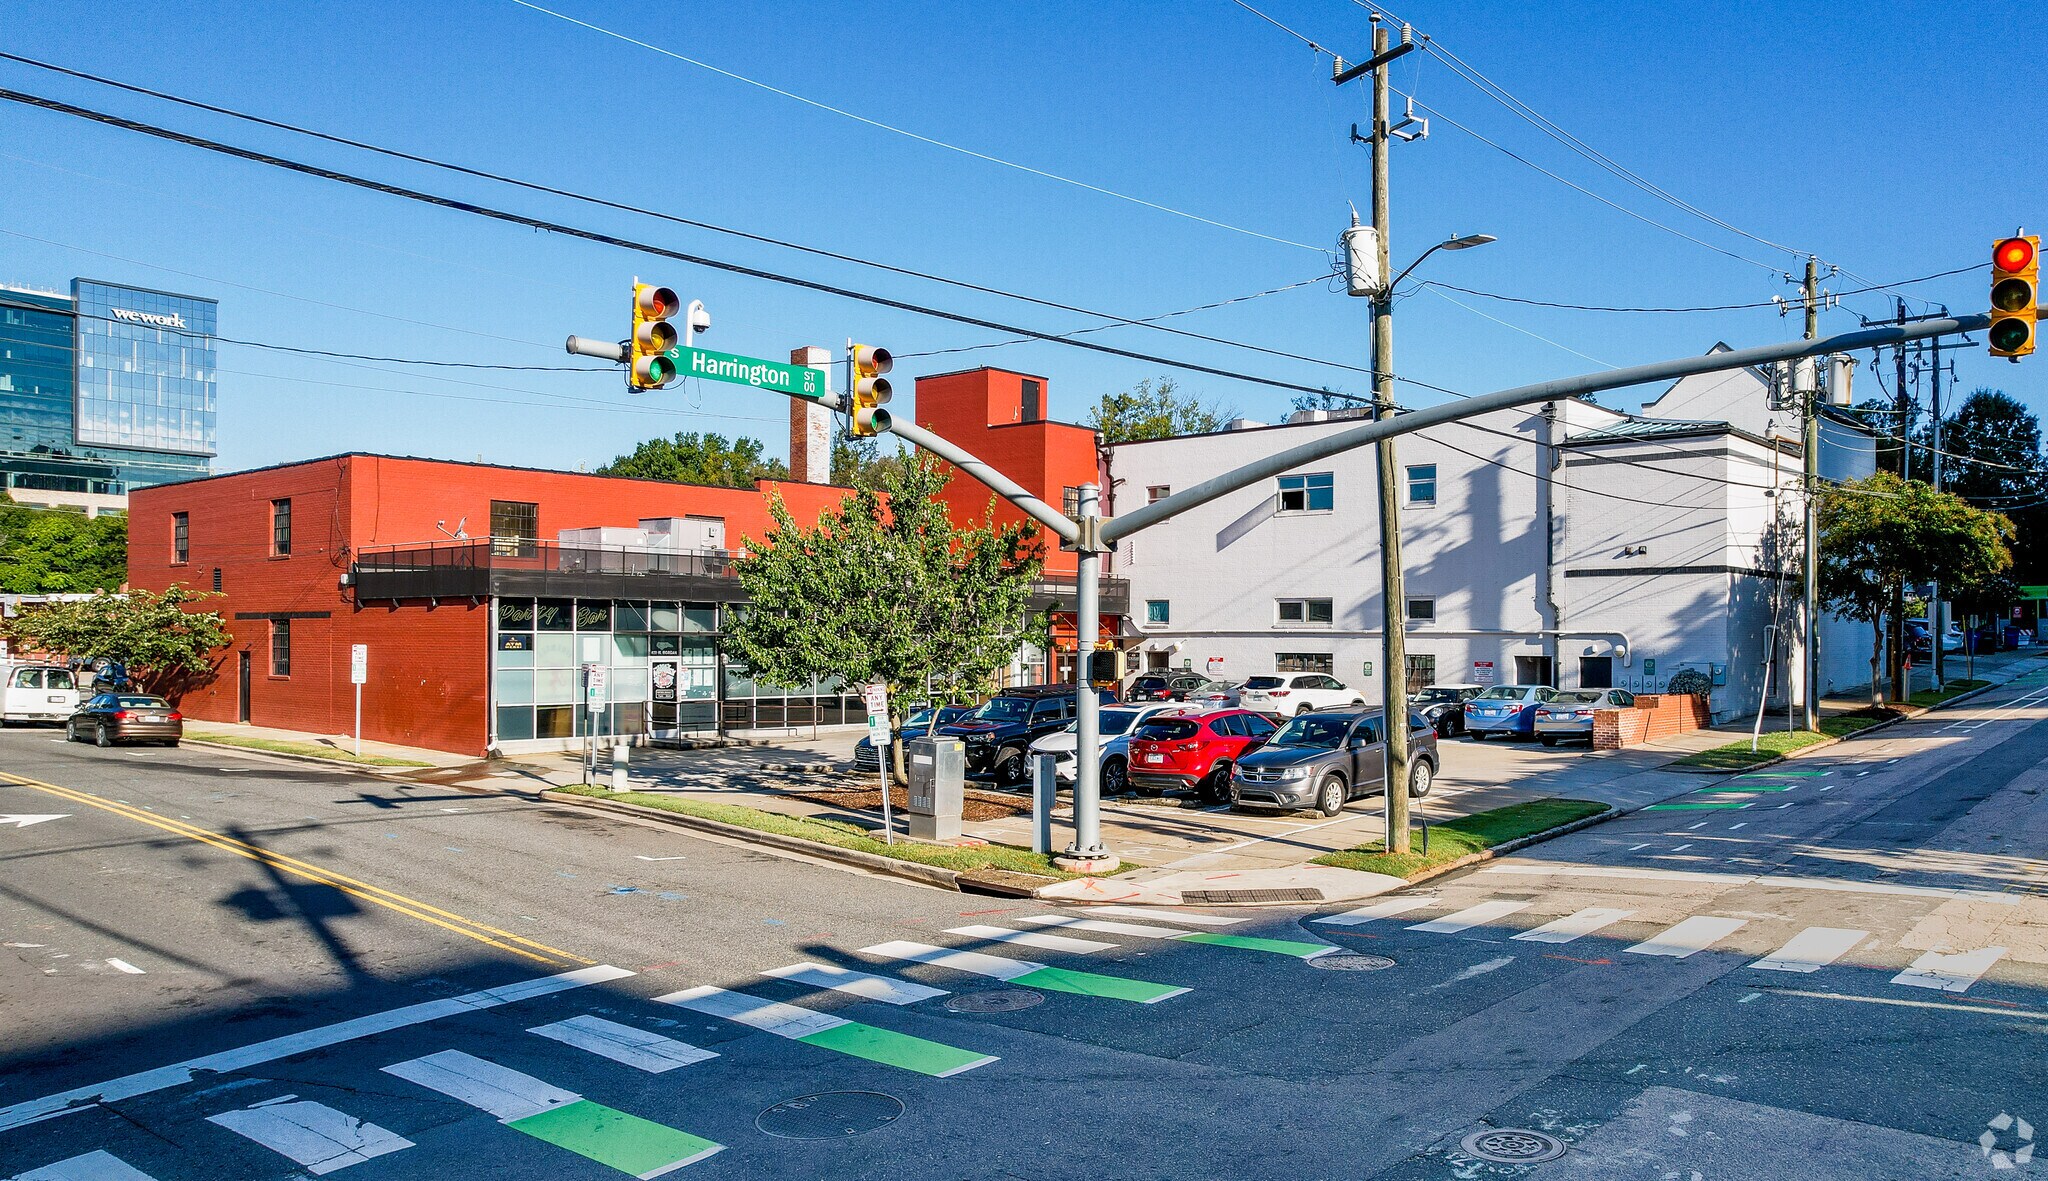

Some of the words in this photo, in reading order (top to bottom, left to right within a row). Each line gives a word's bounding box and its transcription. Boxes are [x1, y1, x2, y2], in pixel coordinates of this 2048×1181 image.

[111, 308, 187, 329] wework
[670, 347, 680, 359] S
[692, 351, 790, 386] Harrington
[804, 370, 815, 382] ST
[804, 381, 815, 393] 00
[498, 604, 559, 626] Party
[577, 606, 607, 628] Bar
